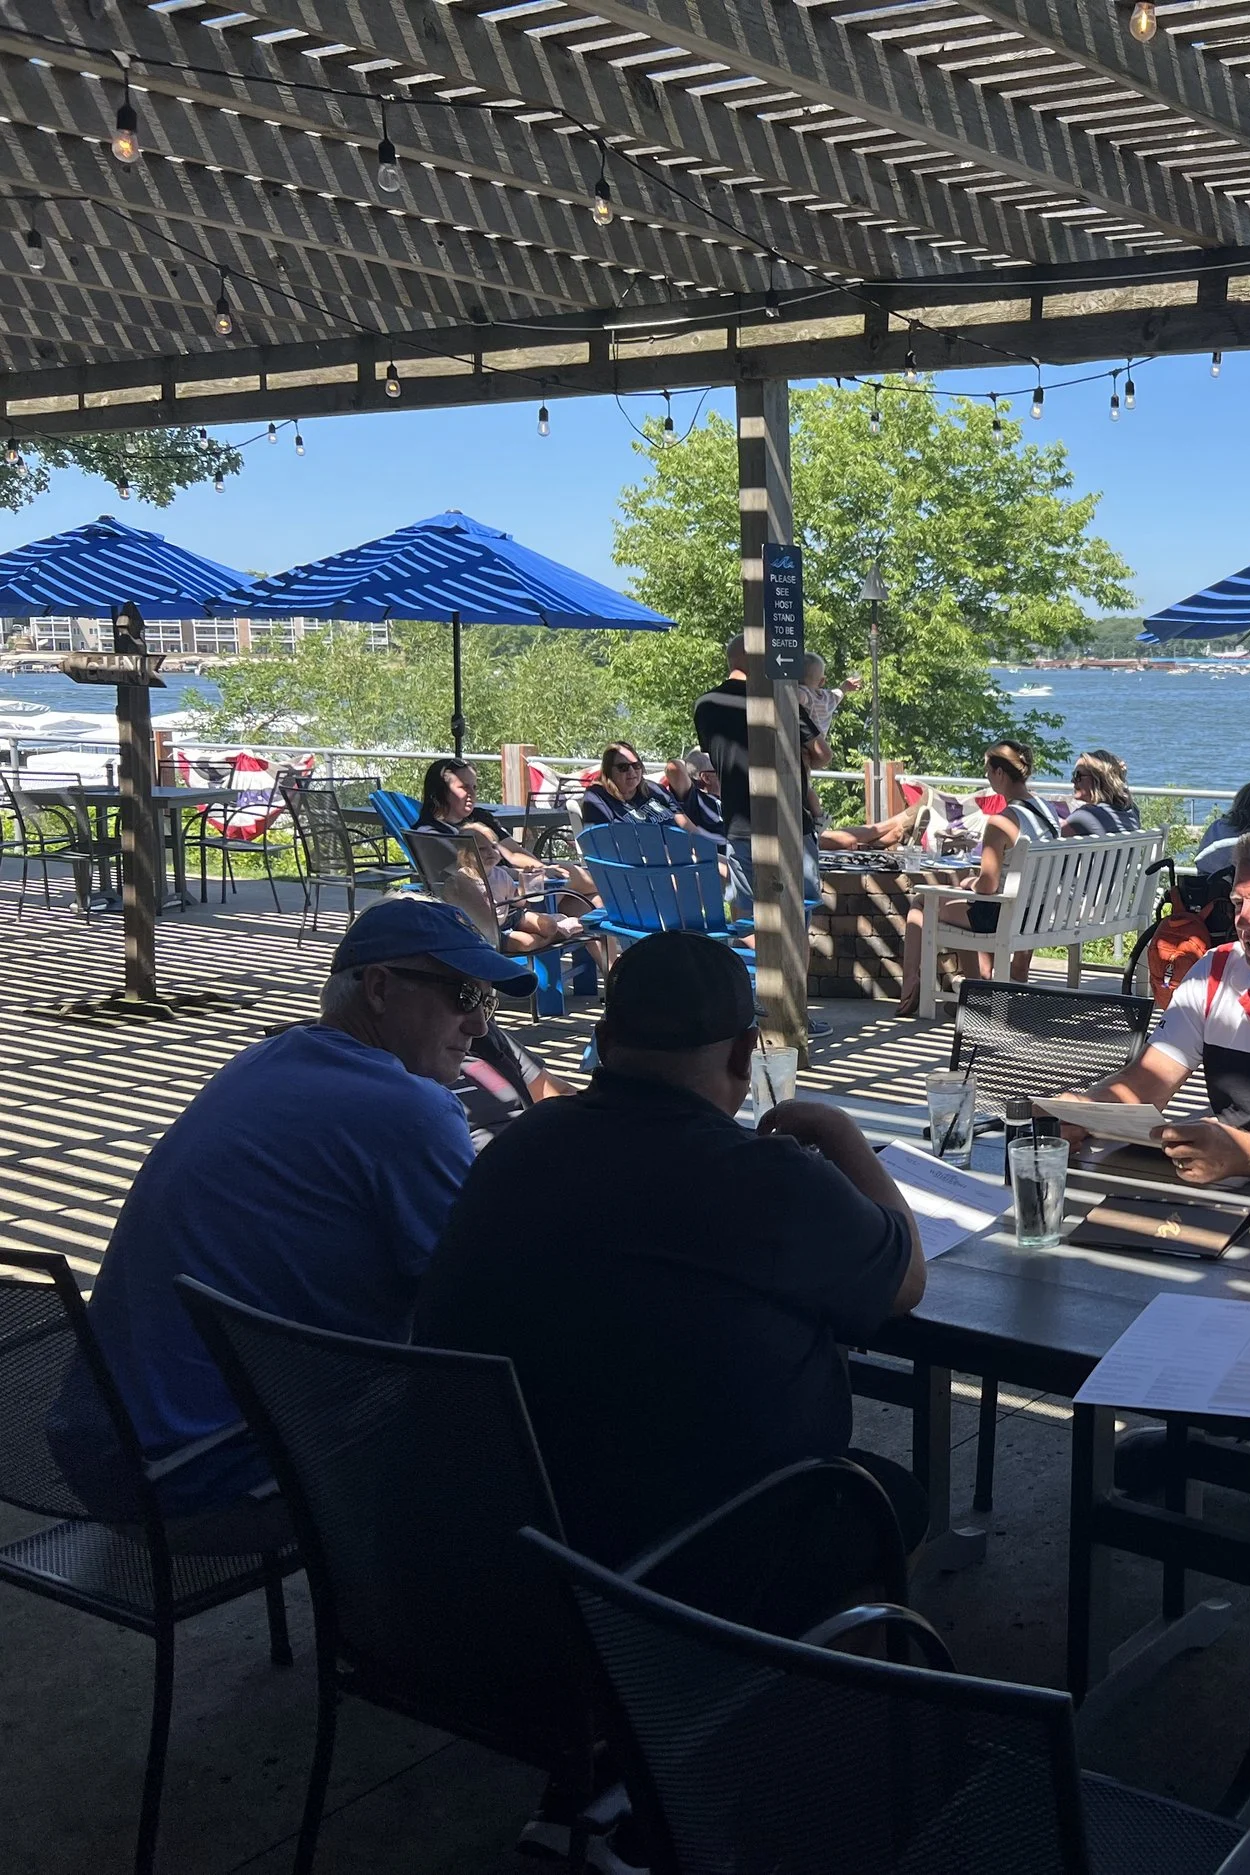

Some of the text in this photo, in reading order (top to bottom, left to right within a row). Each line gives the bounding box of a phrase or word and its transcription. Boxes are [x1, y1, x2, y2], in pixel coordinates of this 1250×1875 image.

[770, 574, 796, 584] PLEASE
[775, 587, 790, 596] SEE
[774, 600, 793, 609] HOST
[773, 613, 795, 622] STAND
[775, 625, 795, 635] TO BE
[771, 638, 798, 648] SEATED
